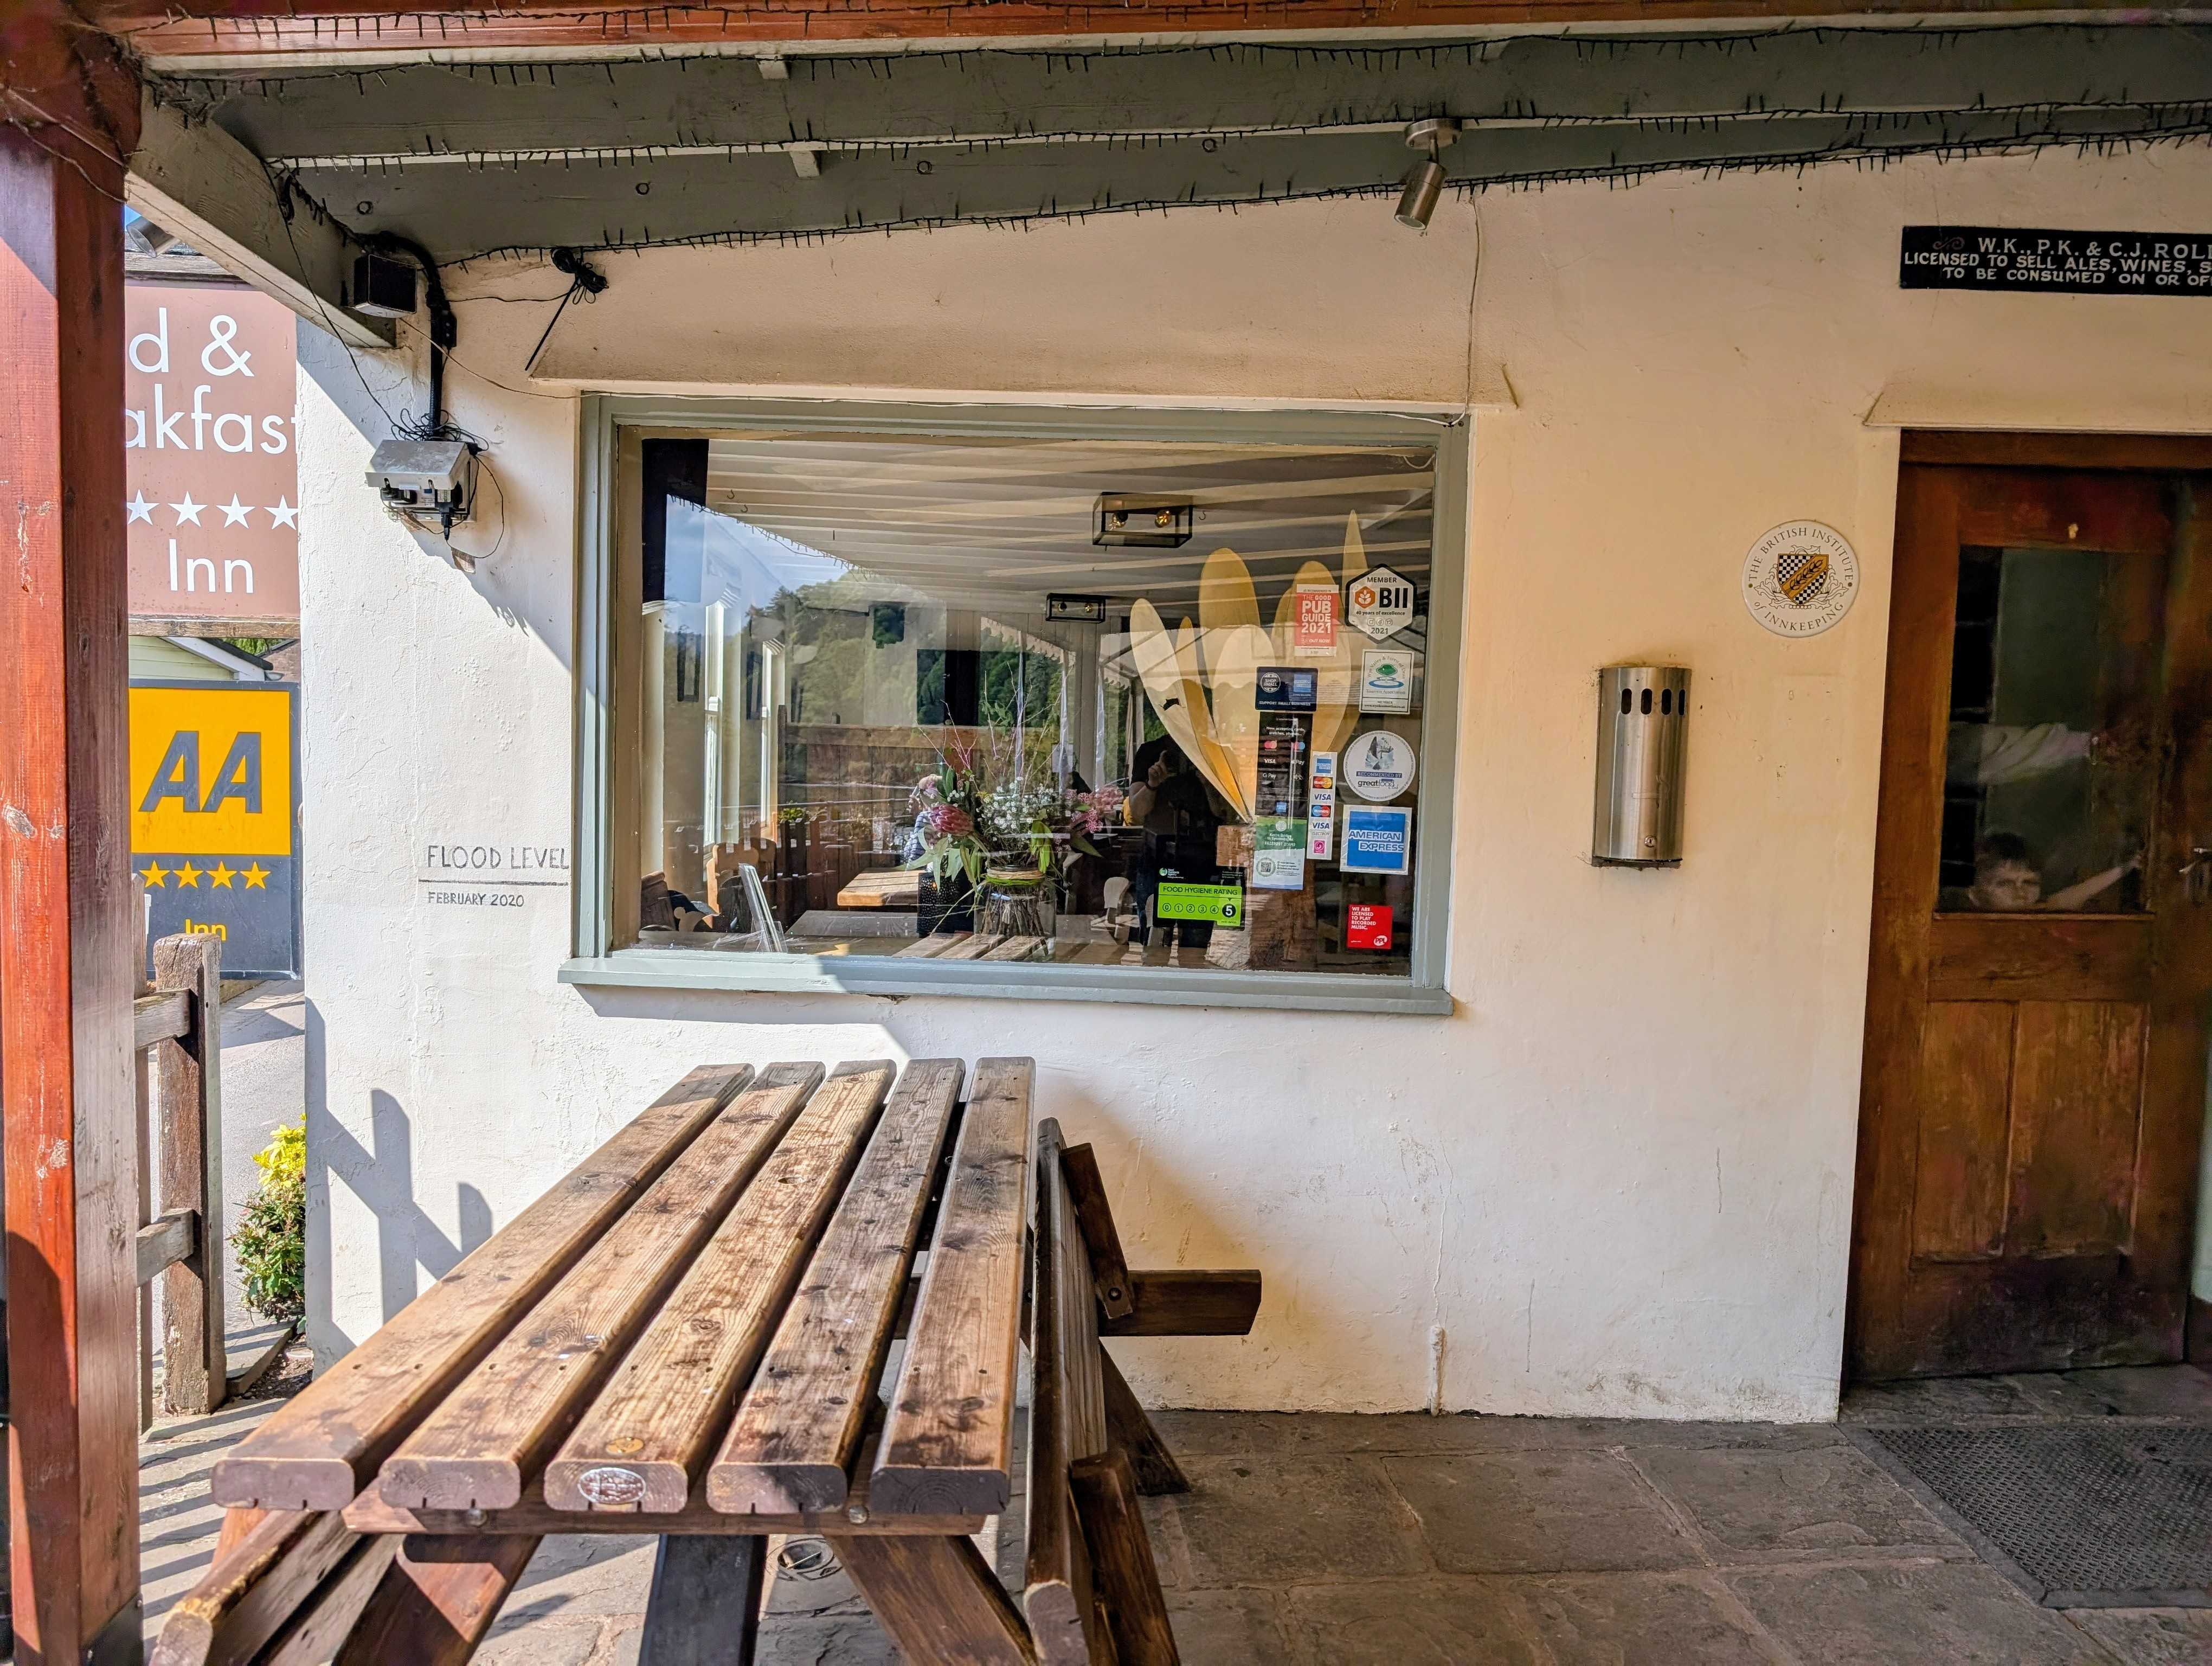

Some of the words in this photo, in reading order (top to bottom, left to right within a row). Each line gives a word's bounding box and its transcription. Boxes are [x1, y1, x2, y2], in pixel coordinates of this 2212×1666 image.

[2037, 239, 2079, 256] P.K.
[2086, 242, 2101, 256] &
[2109, 242, 2147, 258] C.J.
[1905, 252, 1979, 266] LICENSED
[1986, 254, 2008, 267] TO
[2016, 255, 2057, 269] SELL
[1943, 267, 1965, 279] TO
[1976, 268, 1997, 280] BE
[2007, 270, 2105, 284] CONSUMED
[2118, 273, 2145, 285] ON
[2155, 274, 2181, 285] OR
[201, 315, 255, 377] &
[1748, 556, 1763, 581] THE
[1760, 527, 1807, 554] BRITISH
[1812, 529, 1854, 581] INSTITUTE
[169, 539, 254, 594] Inn
[1302, 600, 1332, 613] PUB
[1379, 587, 1408, 608] BII
[1302, 613, 1332, 622] GUIDE
[1754, 601, 1767, 611] of
[1764, 602, 1843, 631] INNKEEPING
[1301, 622, 1331, 633] 2021
[139, 730, 262, 813] AA
[1348, 830, 1400, 841] AMERICAN
[1359, 842, 1404, 851] EXPRESS
[428, 845, 501, 868] FLOOD
[511, 847, 570, 869] LEVEL
[428, 892, 486, 906] FEBRUARY
[490, 894, 524, 907] 2020
[1225, 905, 1233, 916] 5
